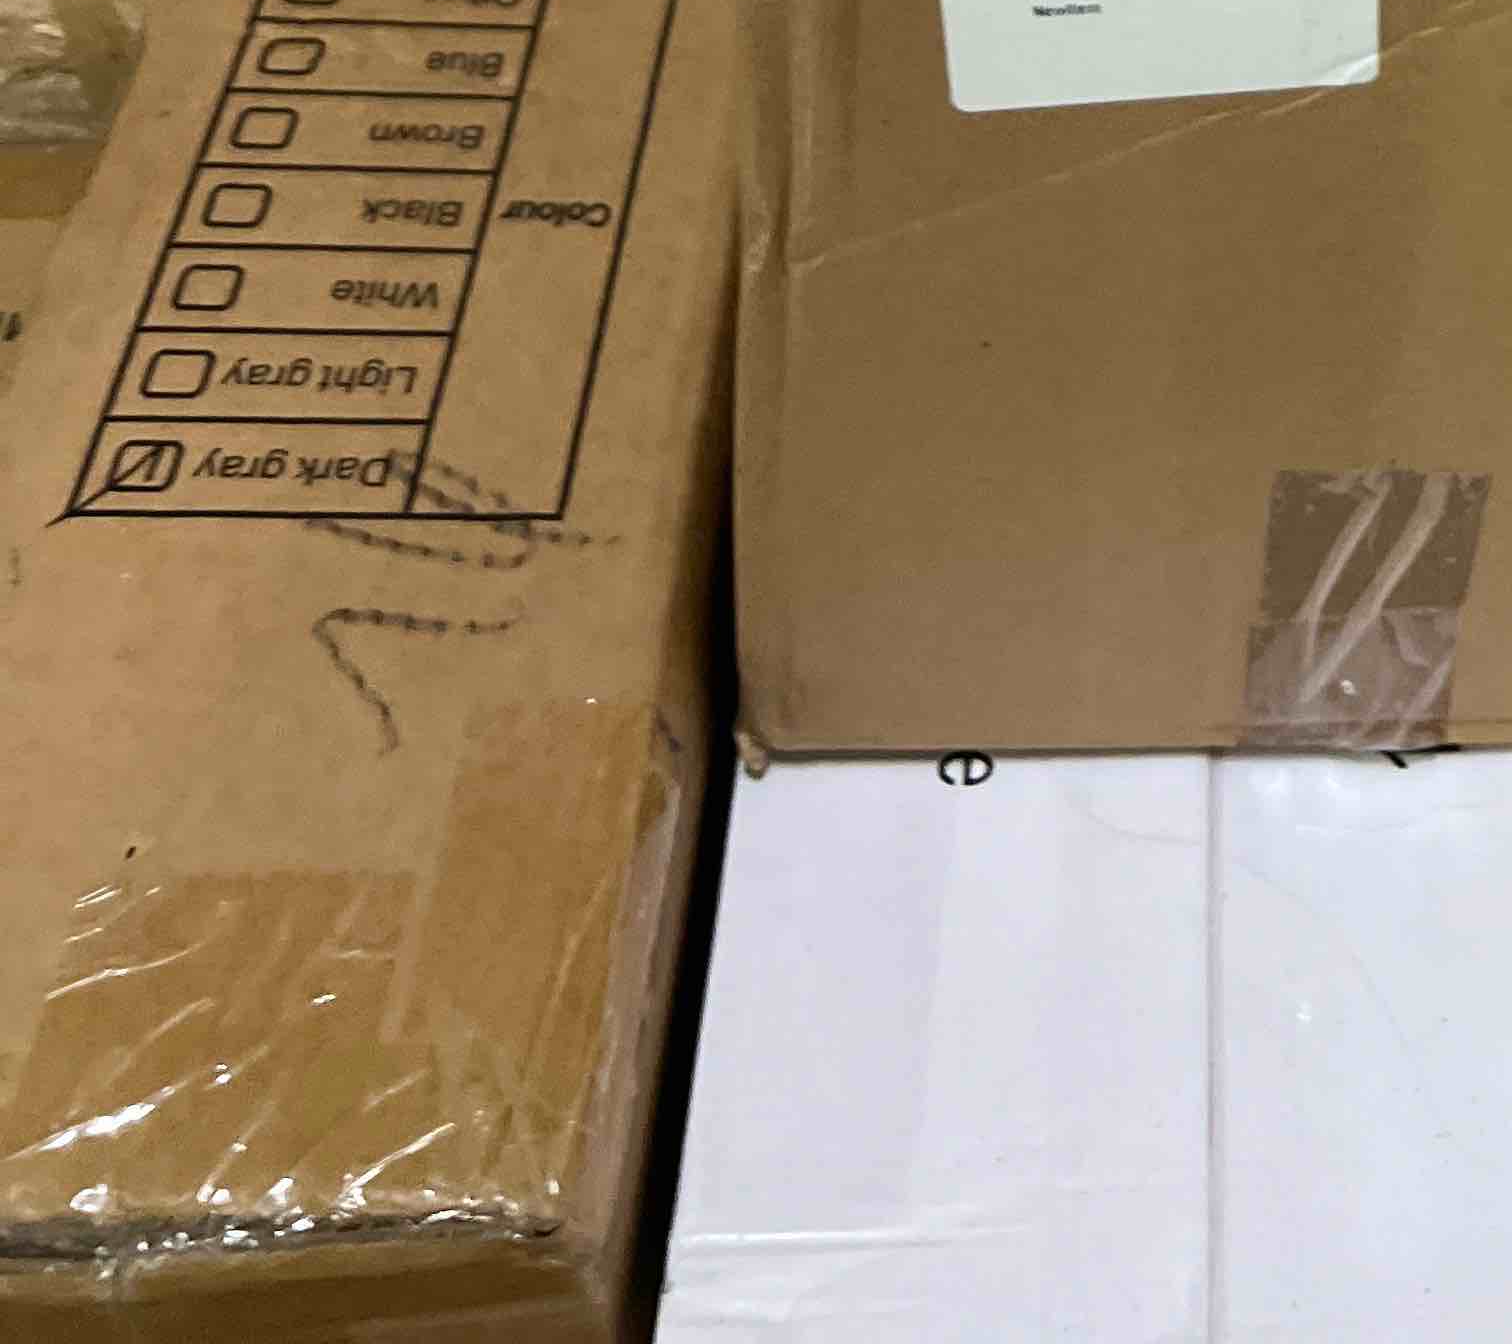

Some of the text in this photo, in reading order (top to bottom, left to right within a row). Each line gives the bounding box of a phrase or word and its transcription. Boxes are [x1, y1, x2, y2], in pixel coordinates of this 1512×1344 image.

[426, 50, 505, 77] Blue
[369, 121, 485, 148] Brown
[362, 197, 463, 227] Black
[502, 197, 612, 227] Colour
[330, 276, 441, 305] White
[221, 357, 418, 396] Light gray
[192, 449, 392, 486] Dark gray
